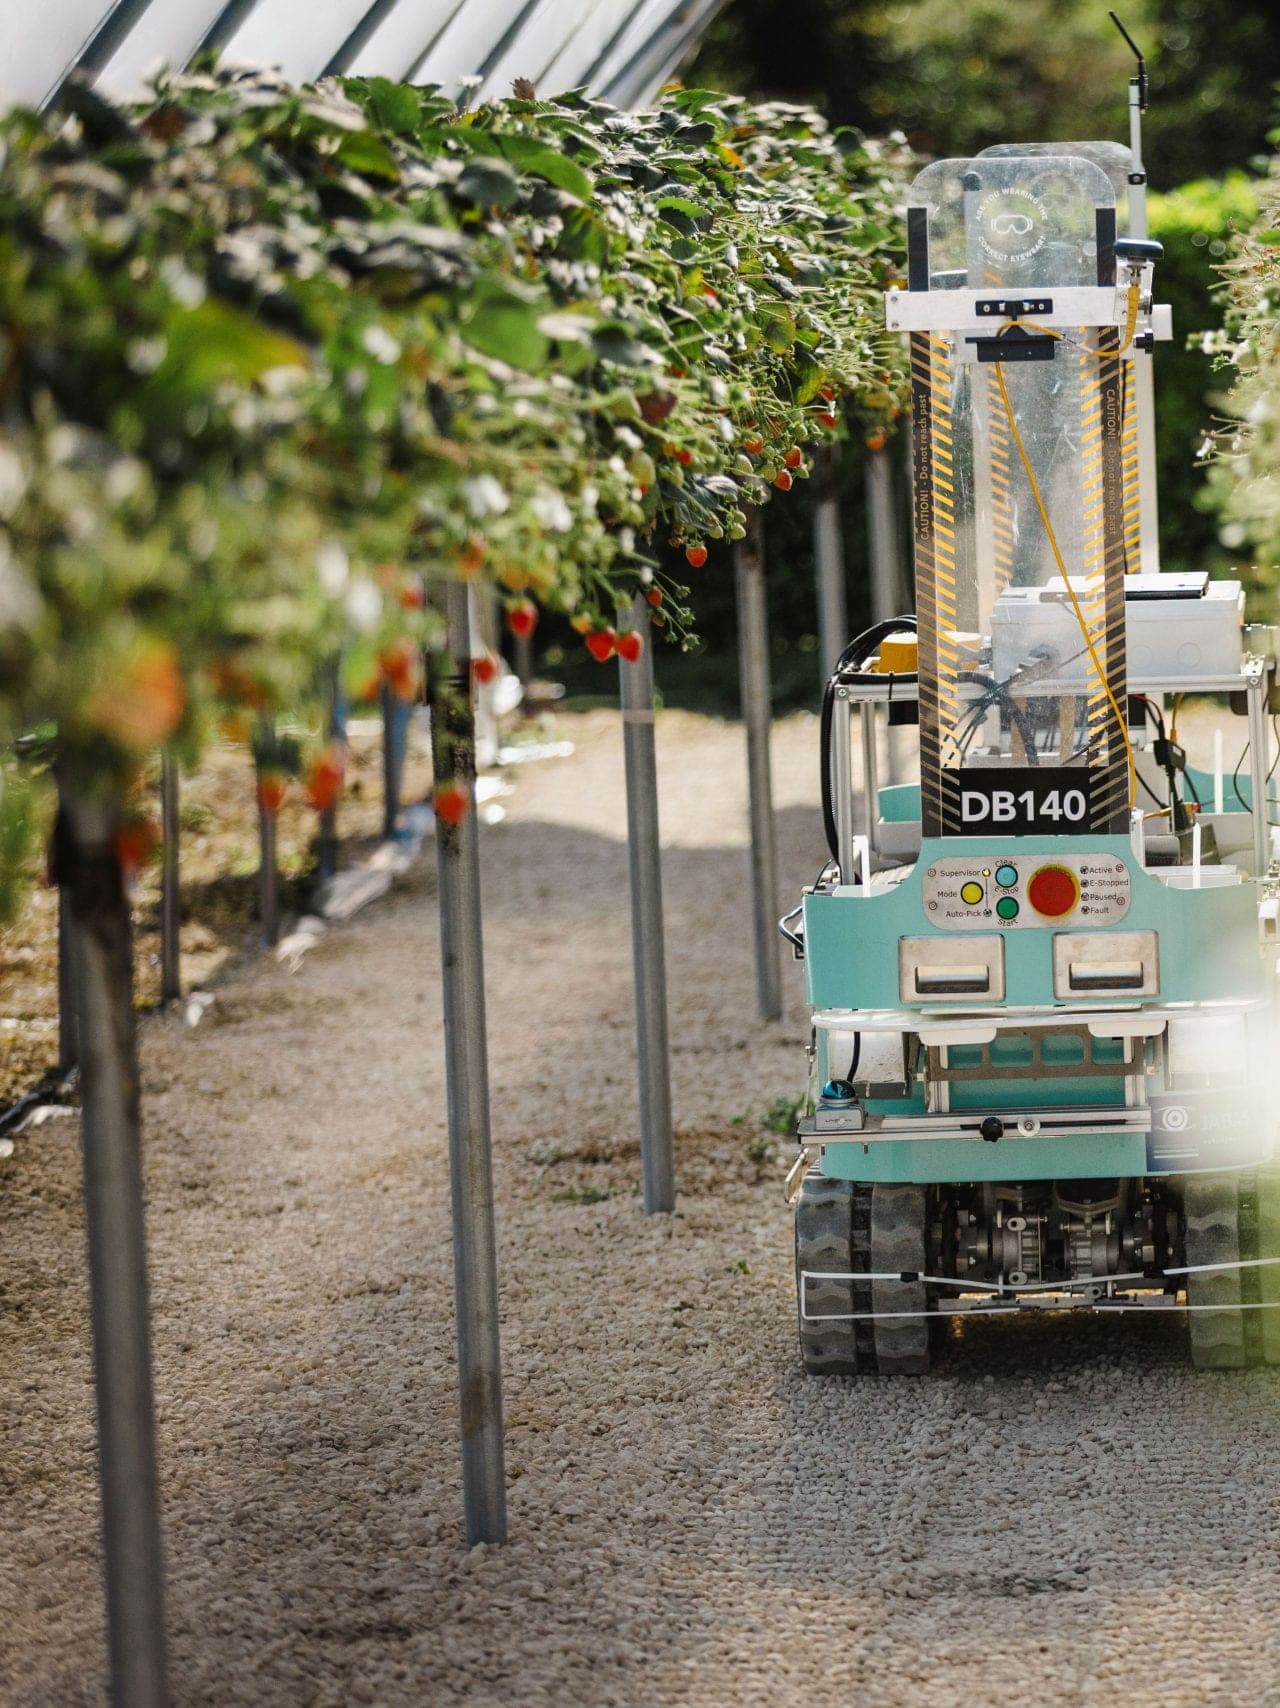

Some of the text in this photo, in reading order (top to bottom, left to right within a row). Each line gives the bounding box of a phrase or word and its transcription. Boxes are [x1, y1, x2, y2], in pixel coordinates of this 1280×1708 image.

[1001, 187, 1039, 204] WEARING
[918, 394, 929, 417] past
[919, 418, 928, 444] reach
[920, 446, 928, 463] not
[919, 464, 929, 480] Do
[920, 489, 930, 541] CAUTION!
[961, 789, 1087, 822] DB140
[940, 870, 980, 878] Supervisor
[1089, 866, 1112, 874] Active
[1090, 879, 1129, 887] E-Stopped
[1090, 893, 1117, 901] Paused
[945, 910, 982, 918] Auto-Pick
[997, 918, 1019, 927] Start
